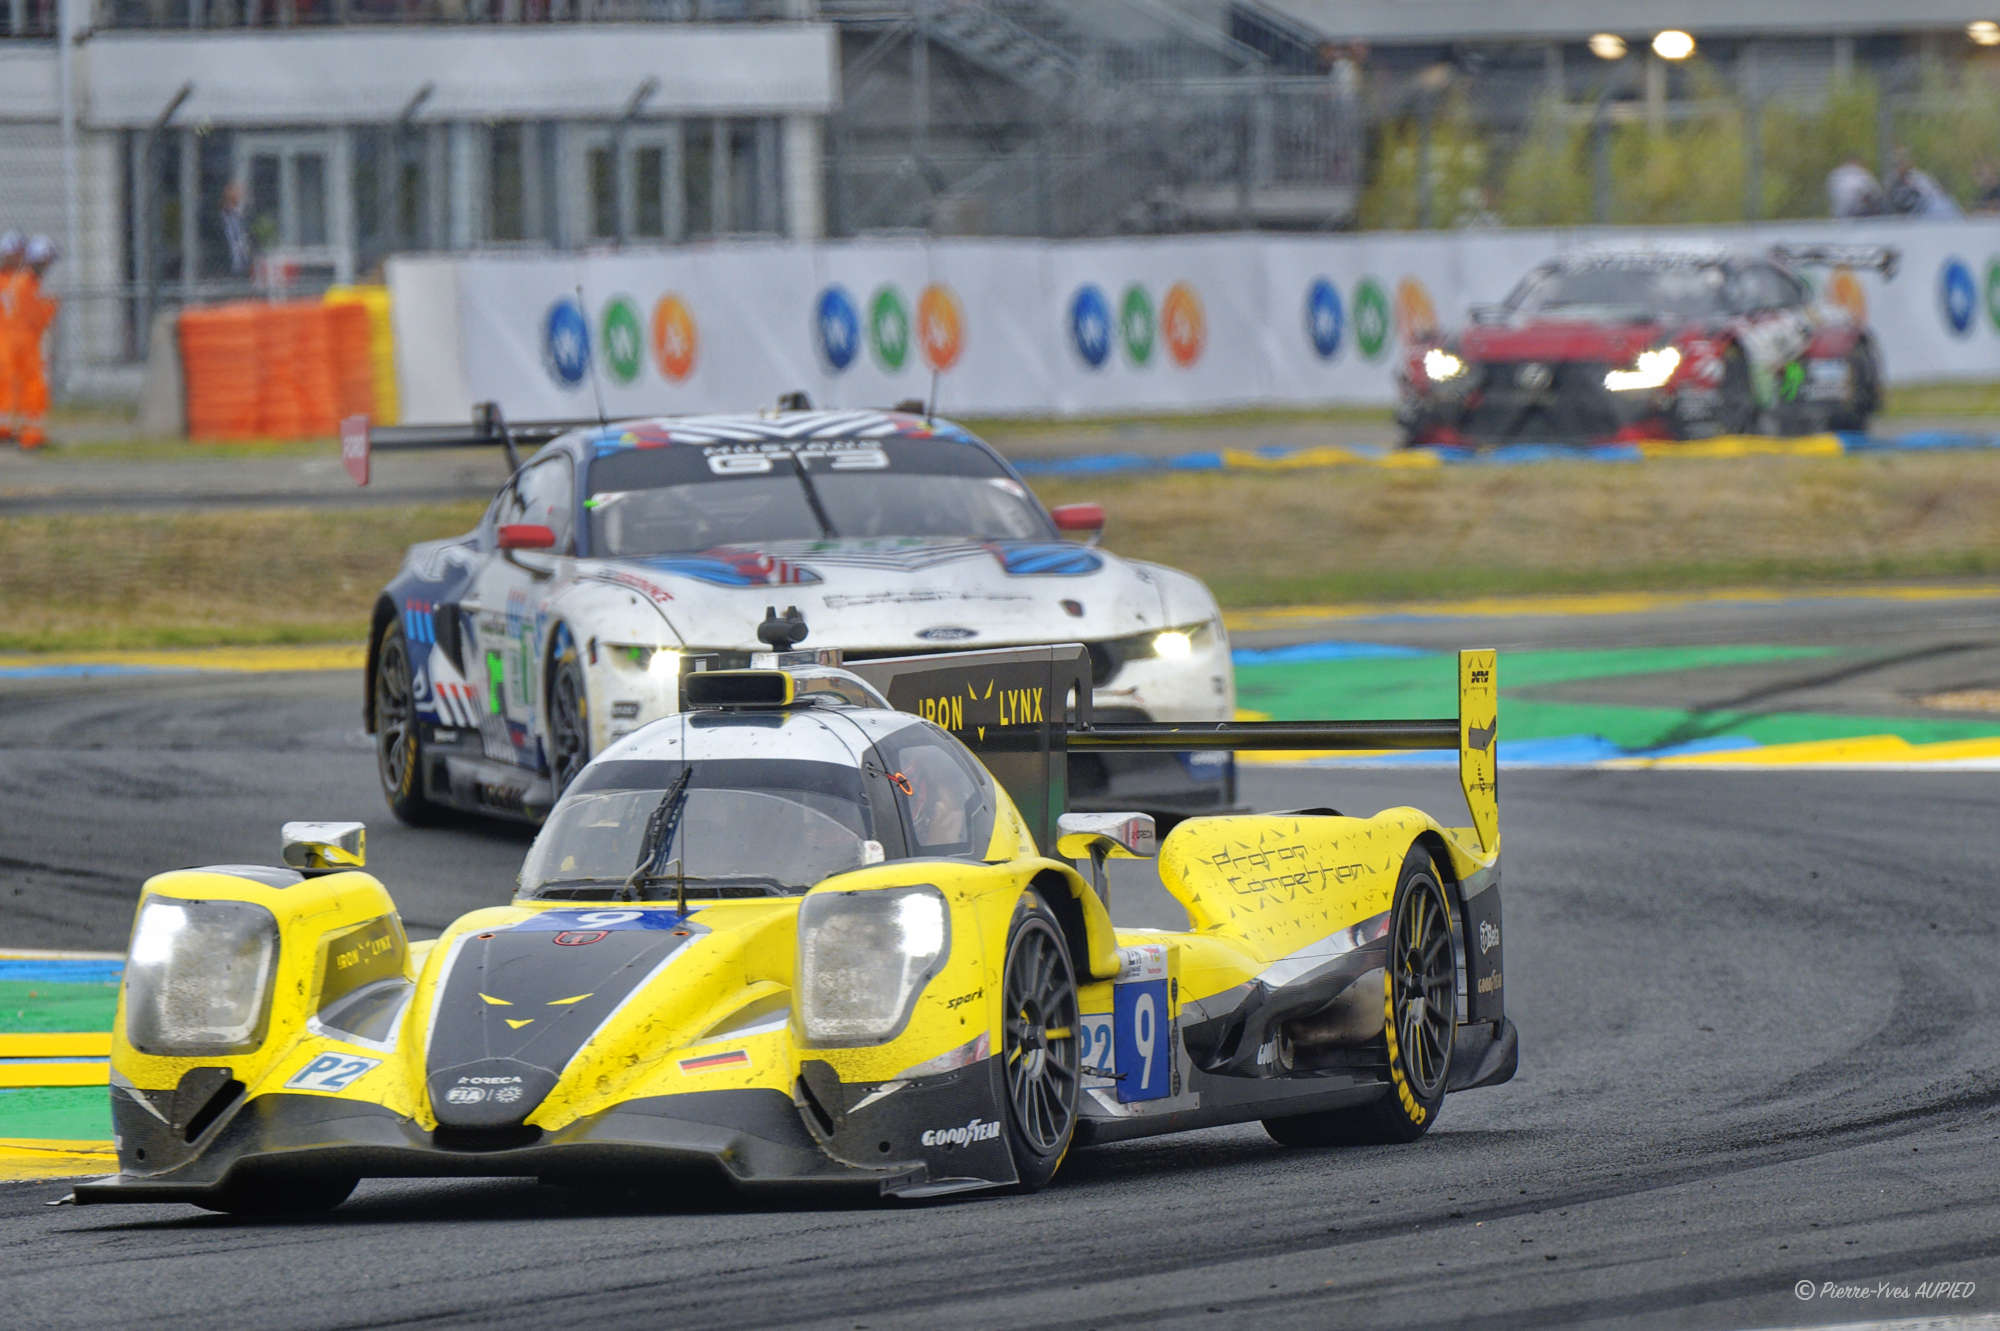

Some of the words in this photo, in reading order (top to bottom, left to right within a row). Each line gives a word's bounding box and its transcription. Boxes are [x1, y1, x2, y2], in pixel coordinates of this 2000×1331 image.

[707, 447, 890, 475] GT3
[999, 686, 1044, 726] LYNX
[577, 911, 645, 929] 9
[1134, 993, 1156, 1090] 9
[292, 1055, 369, 1087] P2
[469, 1076, 523, 1085] ORECA
[448, 1089, 482, 1103] FIA
[920, 1118, 1001, 1148] GOODYEAR
